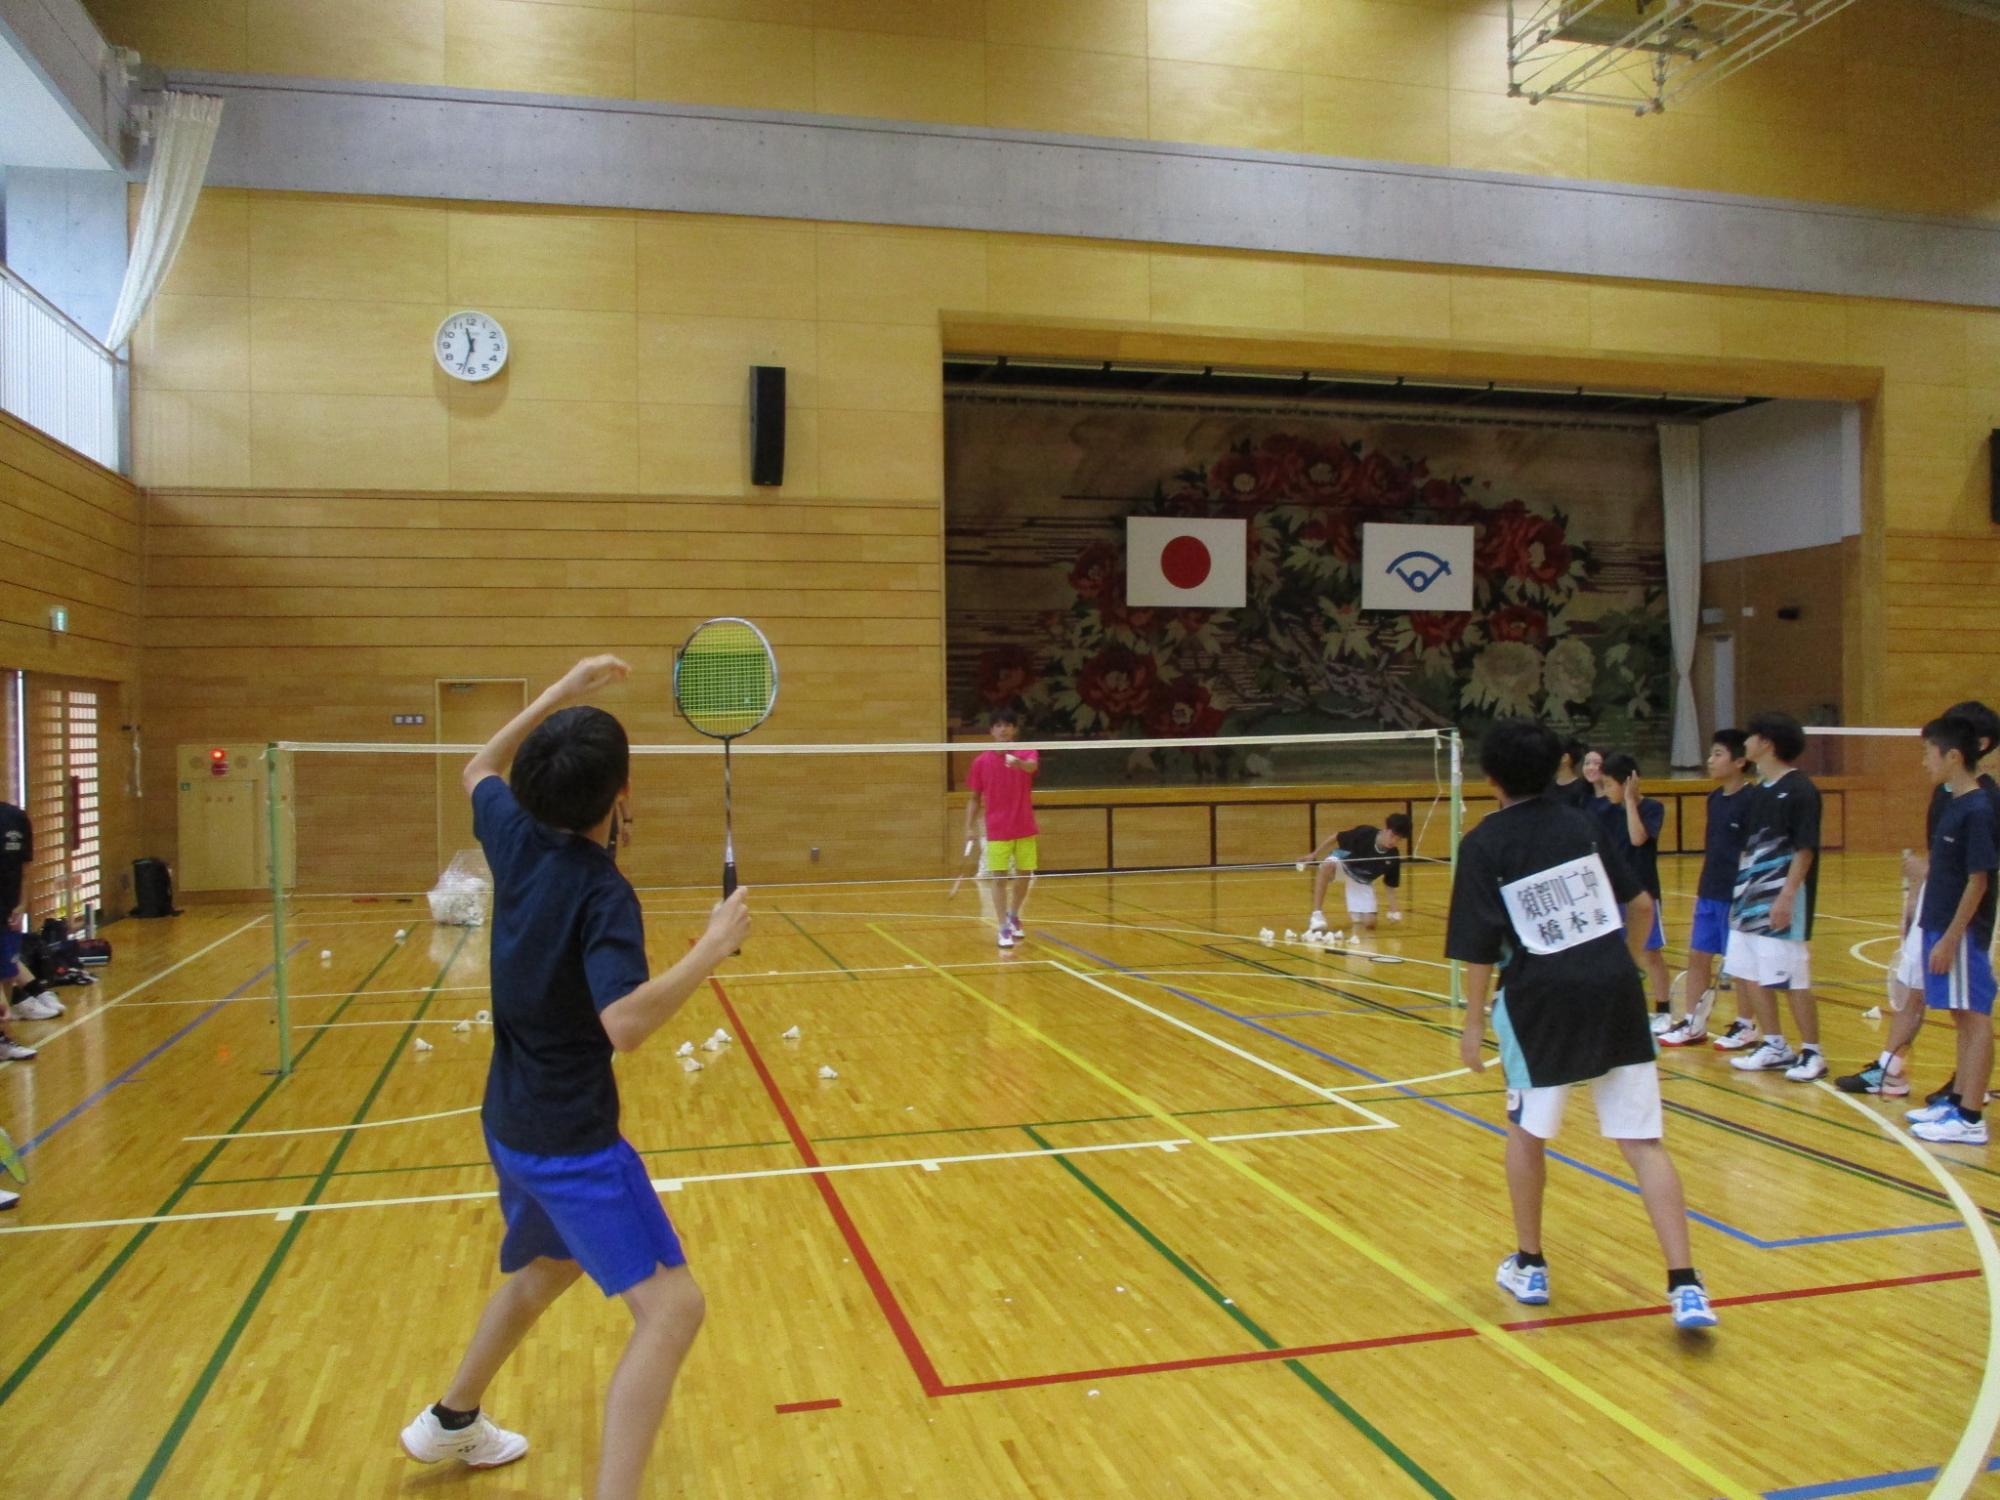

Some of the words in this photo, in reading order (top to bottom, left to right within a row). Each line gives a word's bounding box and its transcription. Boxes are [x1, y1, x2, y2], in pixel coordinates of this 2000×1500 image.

[489, 331, 497, 339] 2
[493, 343, 500, 352] 3
[1517, 865, 1599, 921] 須賀川二中
